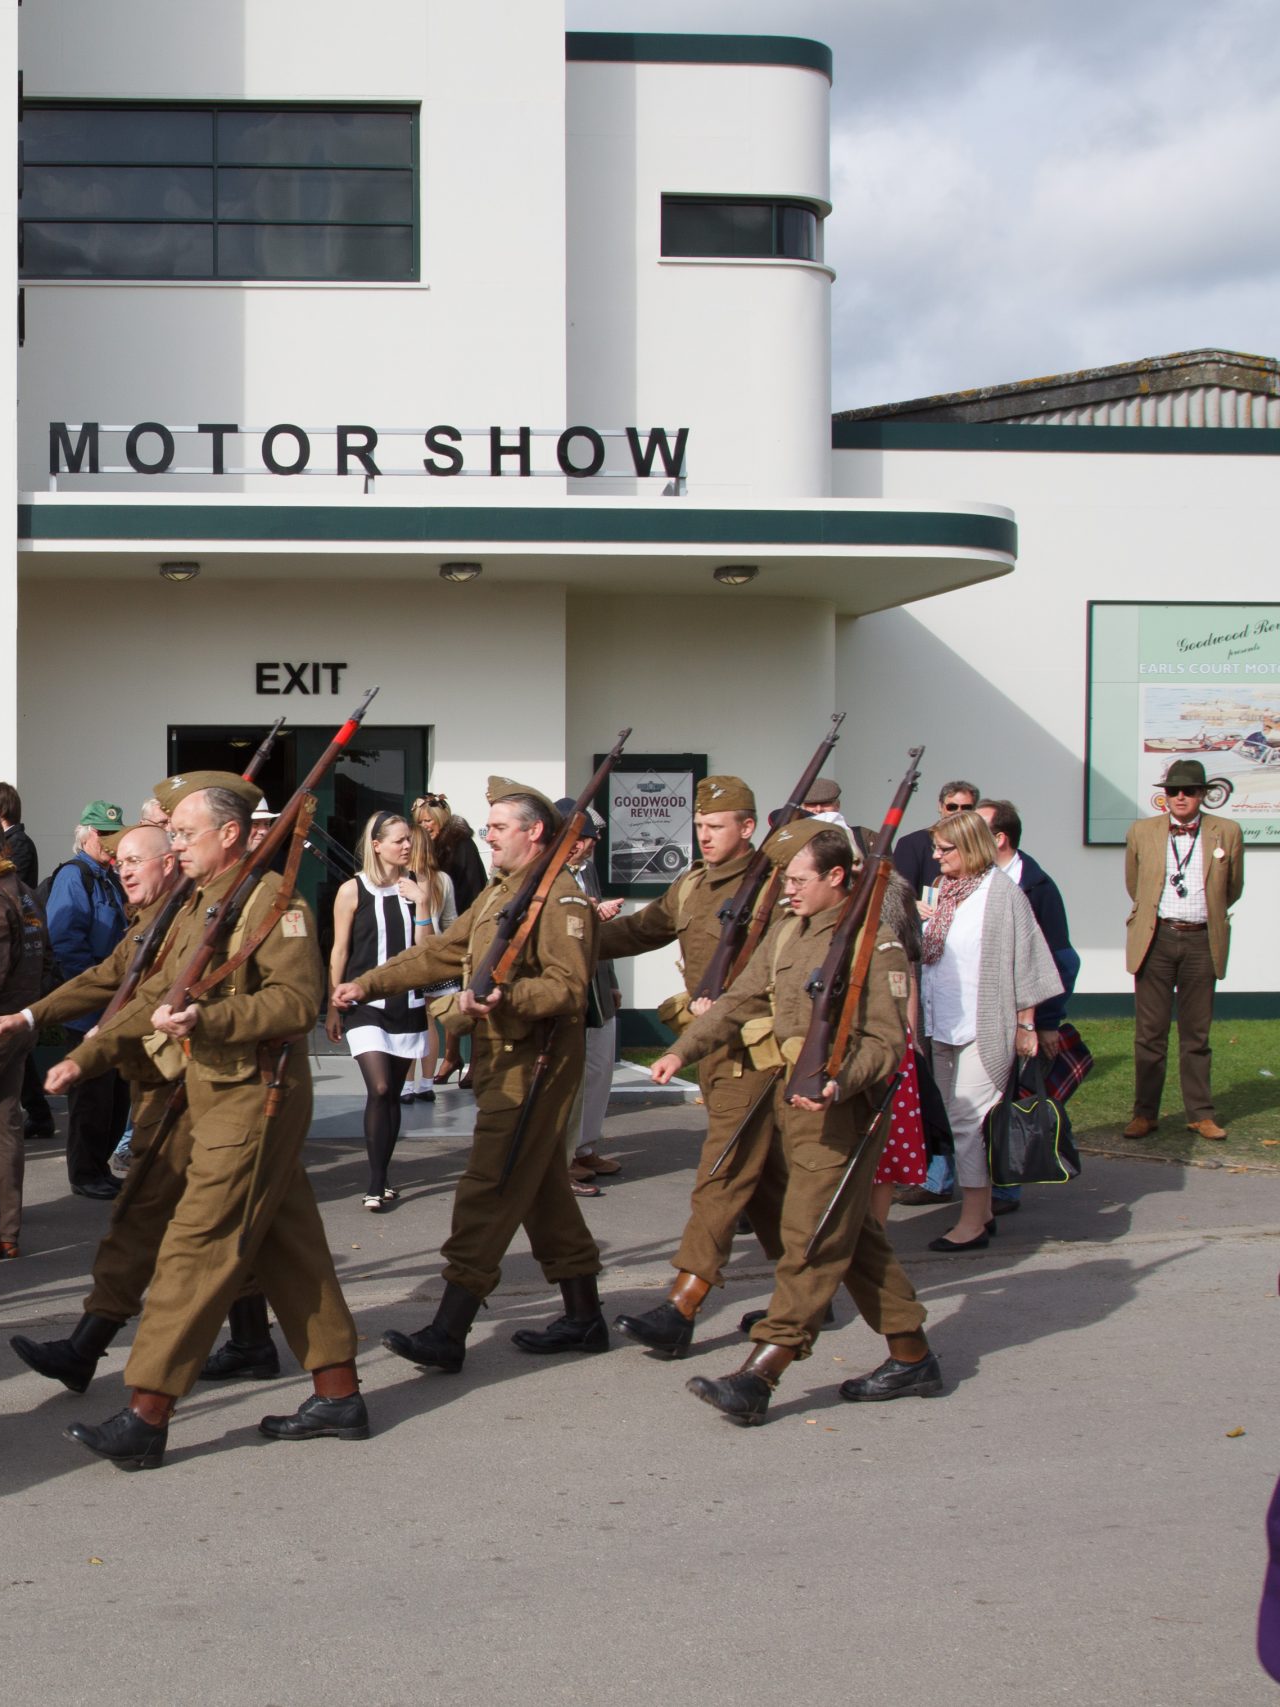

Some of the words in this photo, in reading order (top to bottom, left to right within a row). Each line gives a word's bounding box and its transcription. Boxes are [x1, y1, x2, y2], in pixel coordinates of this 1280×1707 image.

[49, 422, 380, 476] MOTOR
[422, 425, 690, 478] SHOW
[1176, 624, 1250, 652] Goodwood
[1139, 663, 1185, 674] EARLS
[1189, 663, 1241, 674] COURT
[1245, 663, 1280, 674] MOT
[255, 662, 347, 696] EXIT
[614, 796, 686, 808] GOODWOOD
[630, 808, 671, 818] REVIVAL
[285, 912, 300, 922] CP
[892, 974, 904, 984] CP
